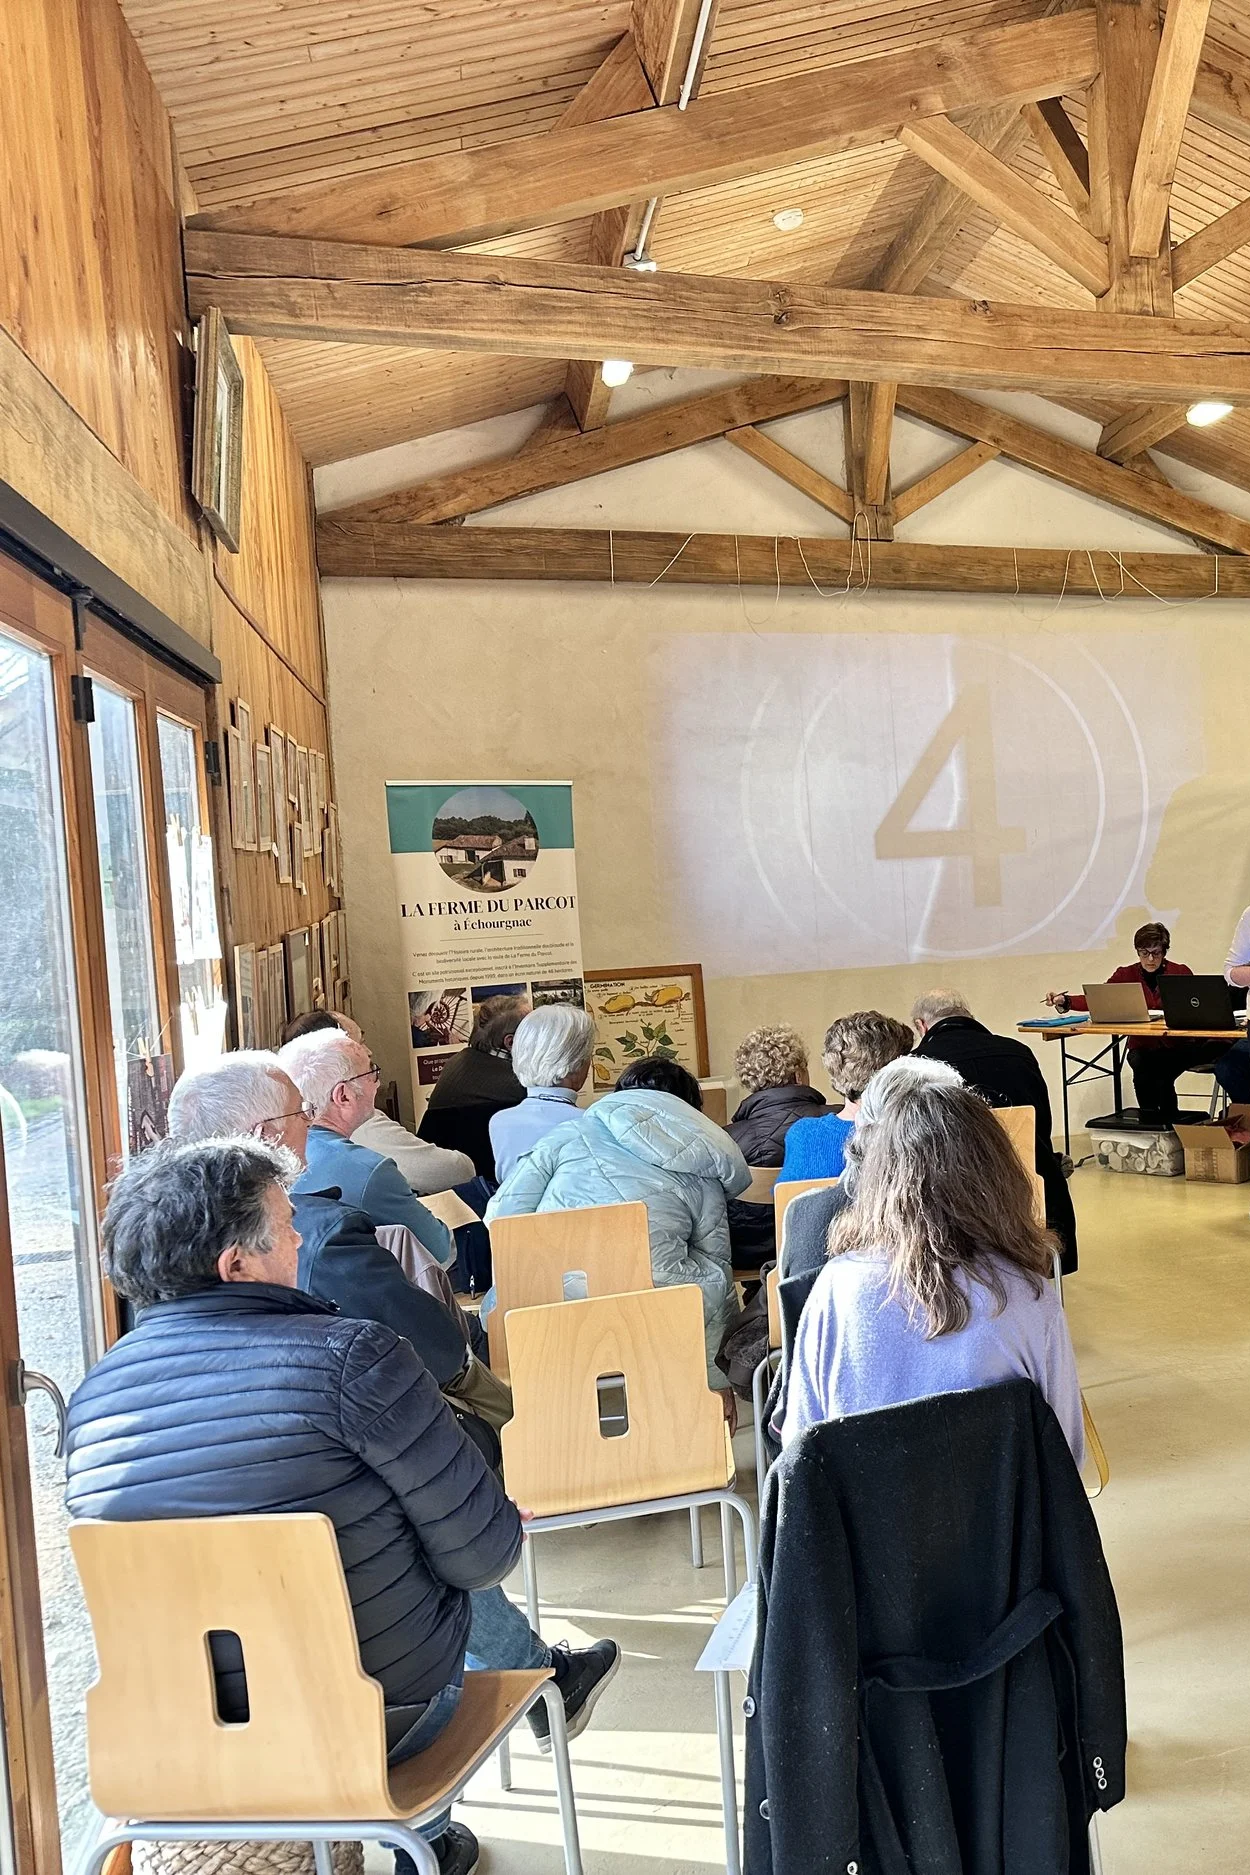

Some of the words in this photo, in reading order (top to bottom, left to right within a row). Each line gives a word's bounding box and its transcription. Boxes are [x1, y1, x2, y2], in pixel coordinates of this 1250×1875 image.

[875, 681, 1027, 908] 4
[400, 904, 424, 918] LA
[428, 900, 484, 916] FERME
[487, 898, 510, 913] DU
[513, 896, 576, 912] PARCOT
[453, 919, 461, 931] à
[464, 917, 532, 931] Échourgnac
